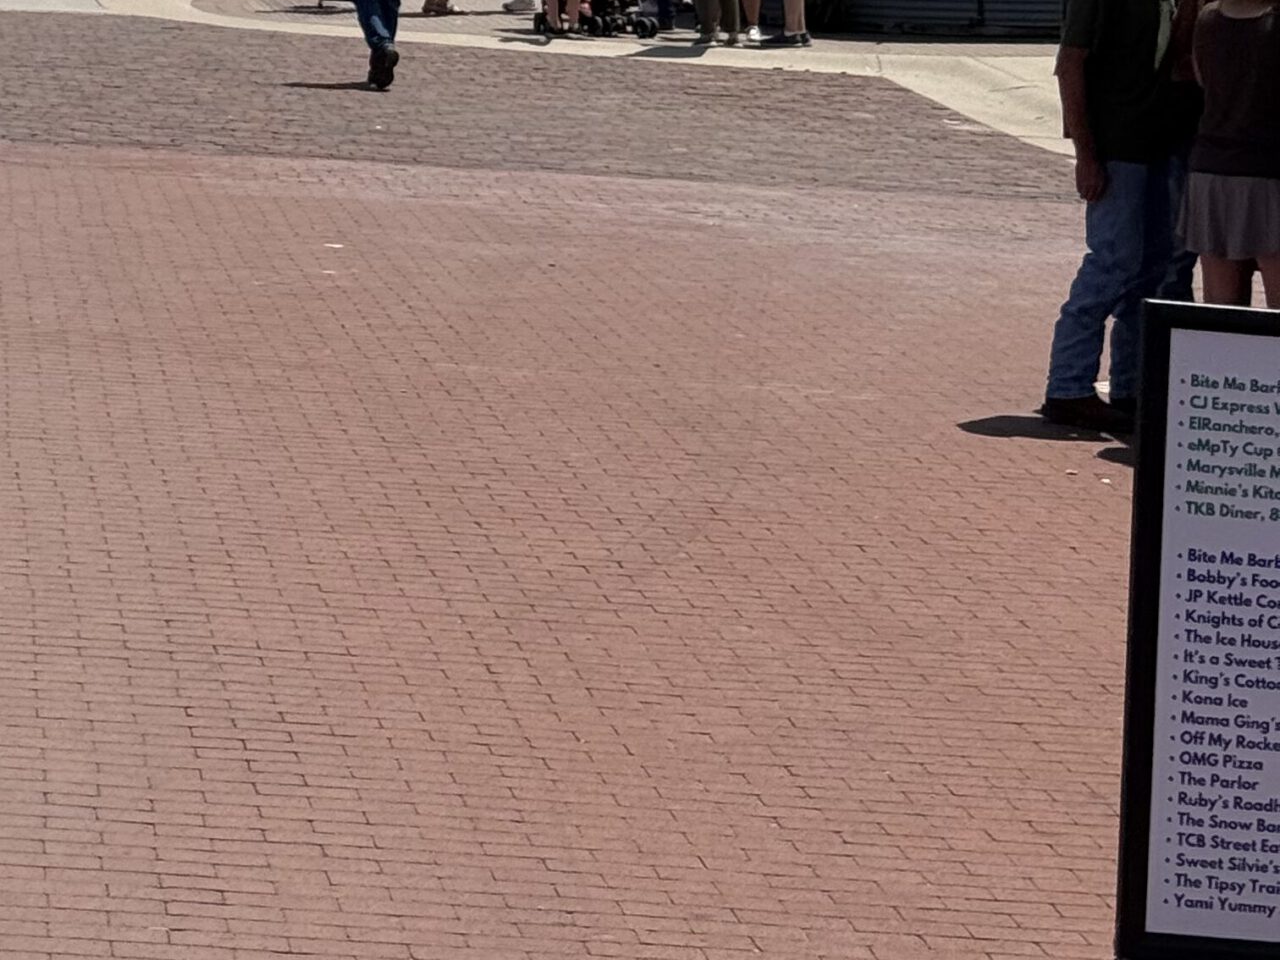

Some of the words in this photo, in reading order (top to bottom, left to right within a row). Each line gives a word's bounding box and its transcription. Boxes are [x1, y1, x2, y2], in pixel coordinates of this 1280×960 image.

[1190, 373, 1220, 390] Bite
[1189, 395, 1208, 410] CJ
[1211, 396, 1270, 416] Express
[1242, 441, 1273, 461] Cup
[1186, 458, 1267, 479] Marysville
[1185, 479, 1249, 500] Minnie's
[1185, 500, 1216, 517] TKB
[1219, 503, 1266, 522] Diner,
[1187, 547, 1218, 564] Bite
[1220, 550, 1245, 566] Me
[1186, 567, 1249, 589] Bobby's
[1251, 573, 1280, 589] Foo
[1184, 588, 1204, 603] JP
[1206, 589, 1253, 608] Kettle
[1184, 608, 1245, 629] Knights
[1247, 613, 1265, 629] of
[1184, 628, 1213, 645] The
[1215, 631, 1237, 647] Ice
[1183, 648, 1207, 665] It's
[1209, 655, 1220, 666] a
[1223, 652, 1273, 671] Sweet
[1182, 668, 1231, 690] King's
[1181, 689, 1223, 707] Kona
[1227, 693, 1249, 709] Ice
[1180, 710, 1230, 728] Mama
[1180, 730, 1207, 746] Off
[1208, 732, 1233, 753] My
[1179, 750, 1219, 768] OMG
[1222, 754, 1264, 771] Pizza
[1178, 771, 1207, 787] The
[1210, 773, 1260, 791] Parlor
[1178, 791, 1230, 812] Ruby's
[1177, 812, 1205, 828] The
[1208, 814, 1254, 831] Snow
[1176, 832, 1207, 849] TCB
[1209, 835, 1257, 852] Street
[1176, 852, 1224, 870] Sweet
[1174, 872, 1203, 889] The
[1205, 875, 1247, 896] Tipsy
[1174, 892, 1215, 910] Yami
[1217, 896, 1277, 919] Yummy
